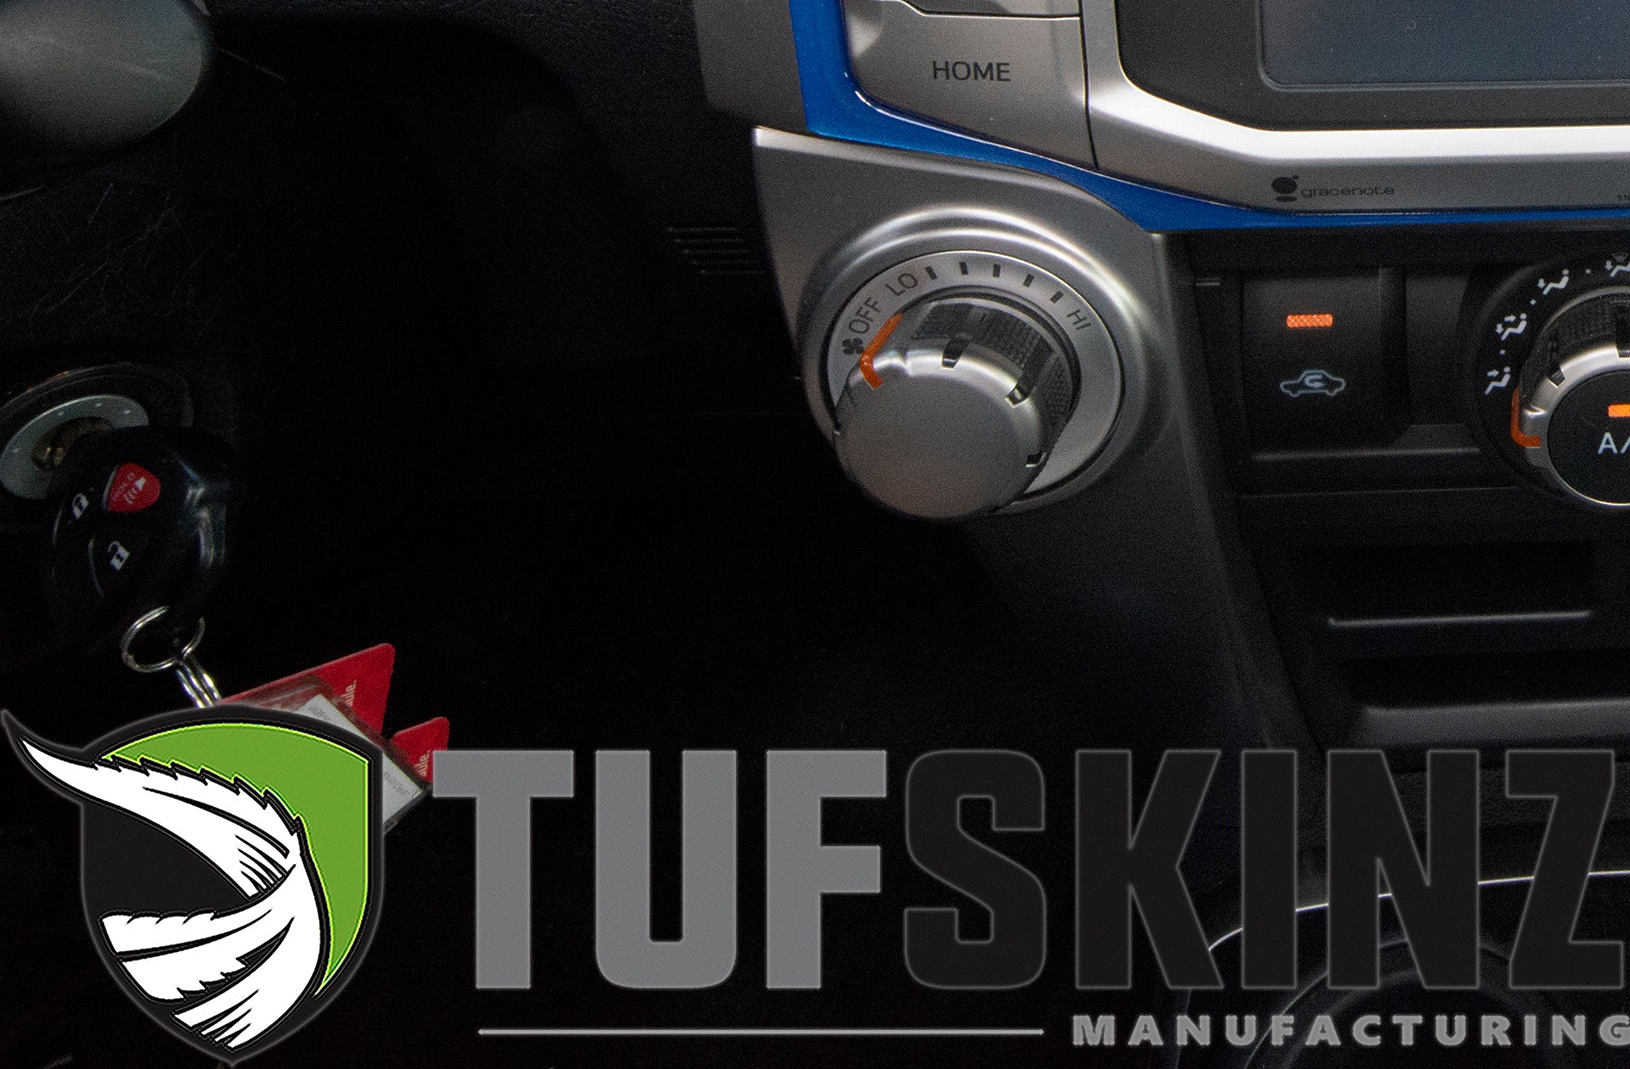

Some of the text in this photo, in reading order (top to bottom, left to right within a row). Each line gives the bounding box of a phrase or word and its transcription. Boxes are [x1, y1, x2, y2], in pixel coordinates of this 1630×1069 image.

[931, 60, 1011, 82] HOME
[1301, 185, 1395, 199] gracenote
[885, 273, 918, 297] LO
[848, 298, 882, 334] OFF
[1067, 308, 1092, 331] HI
